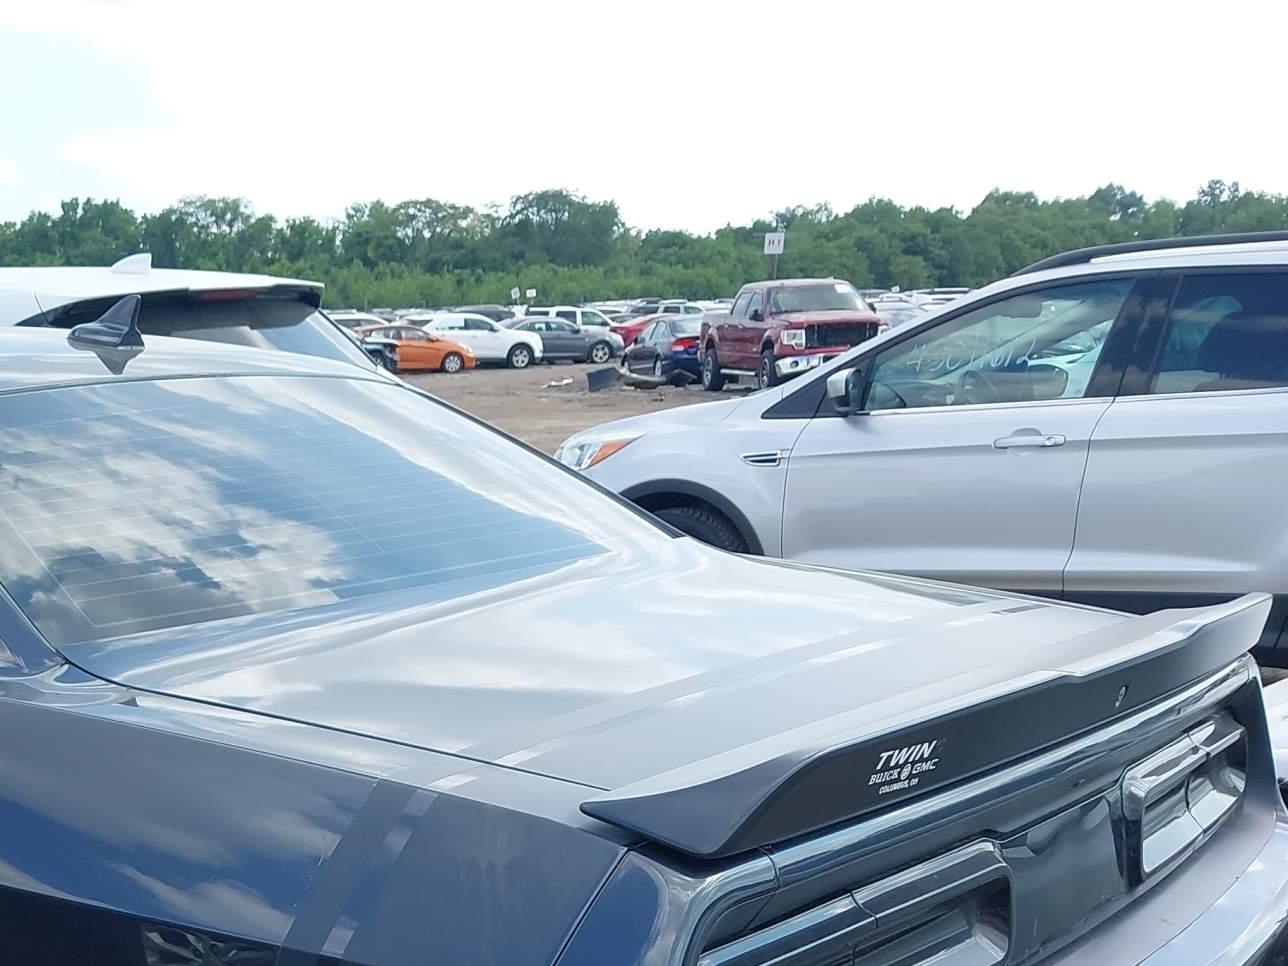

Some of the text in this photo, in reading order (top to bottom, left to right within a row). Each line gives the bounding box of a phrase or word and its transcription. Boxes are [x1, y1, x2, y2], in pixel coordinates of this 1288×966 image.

[876, 740, 937, 770] TWIN
[868, 758, 939, 785] BUICK GMC
